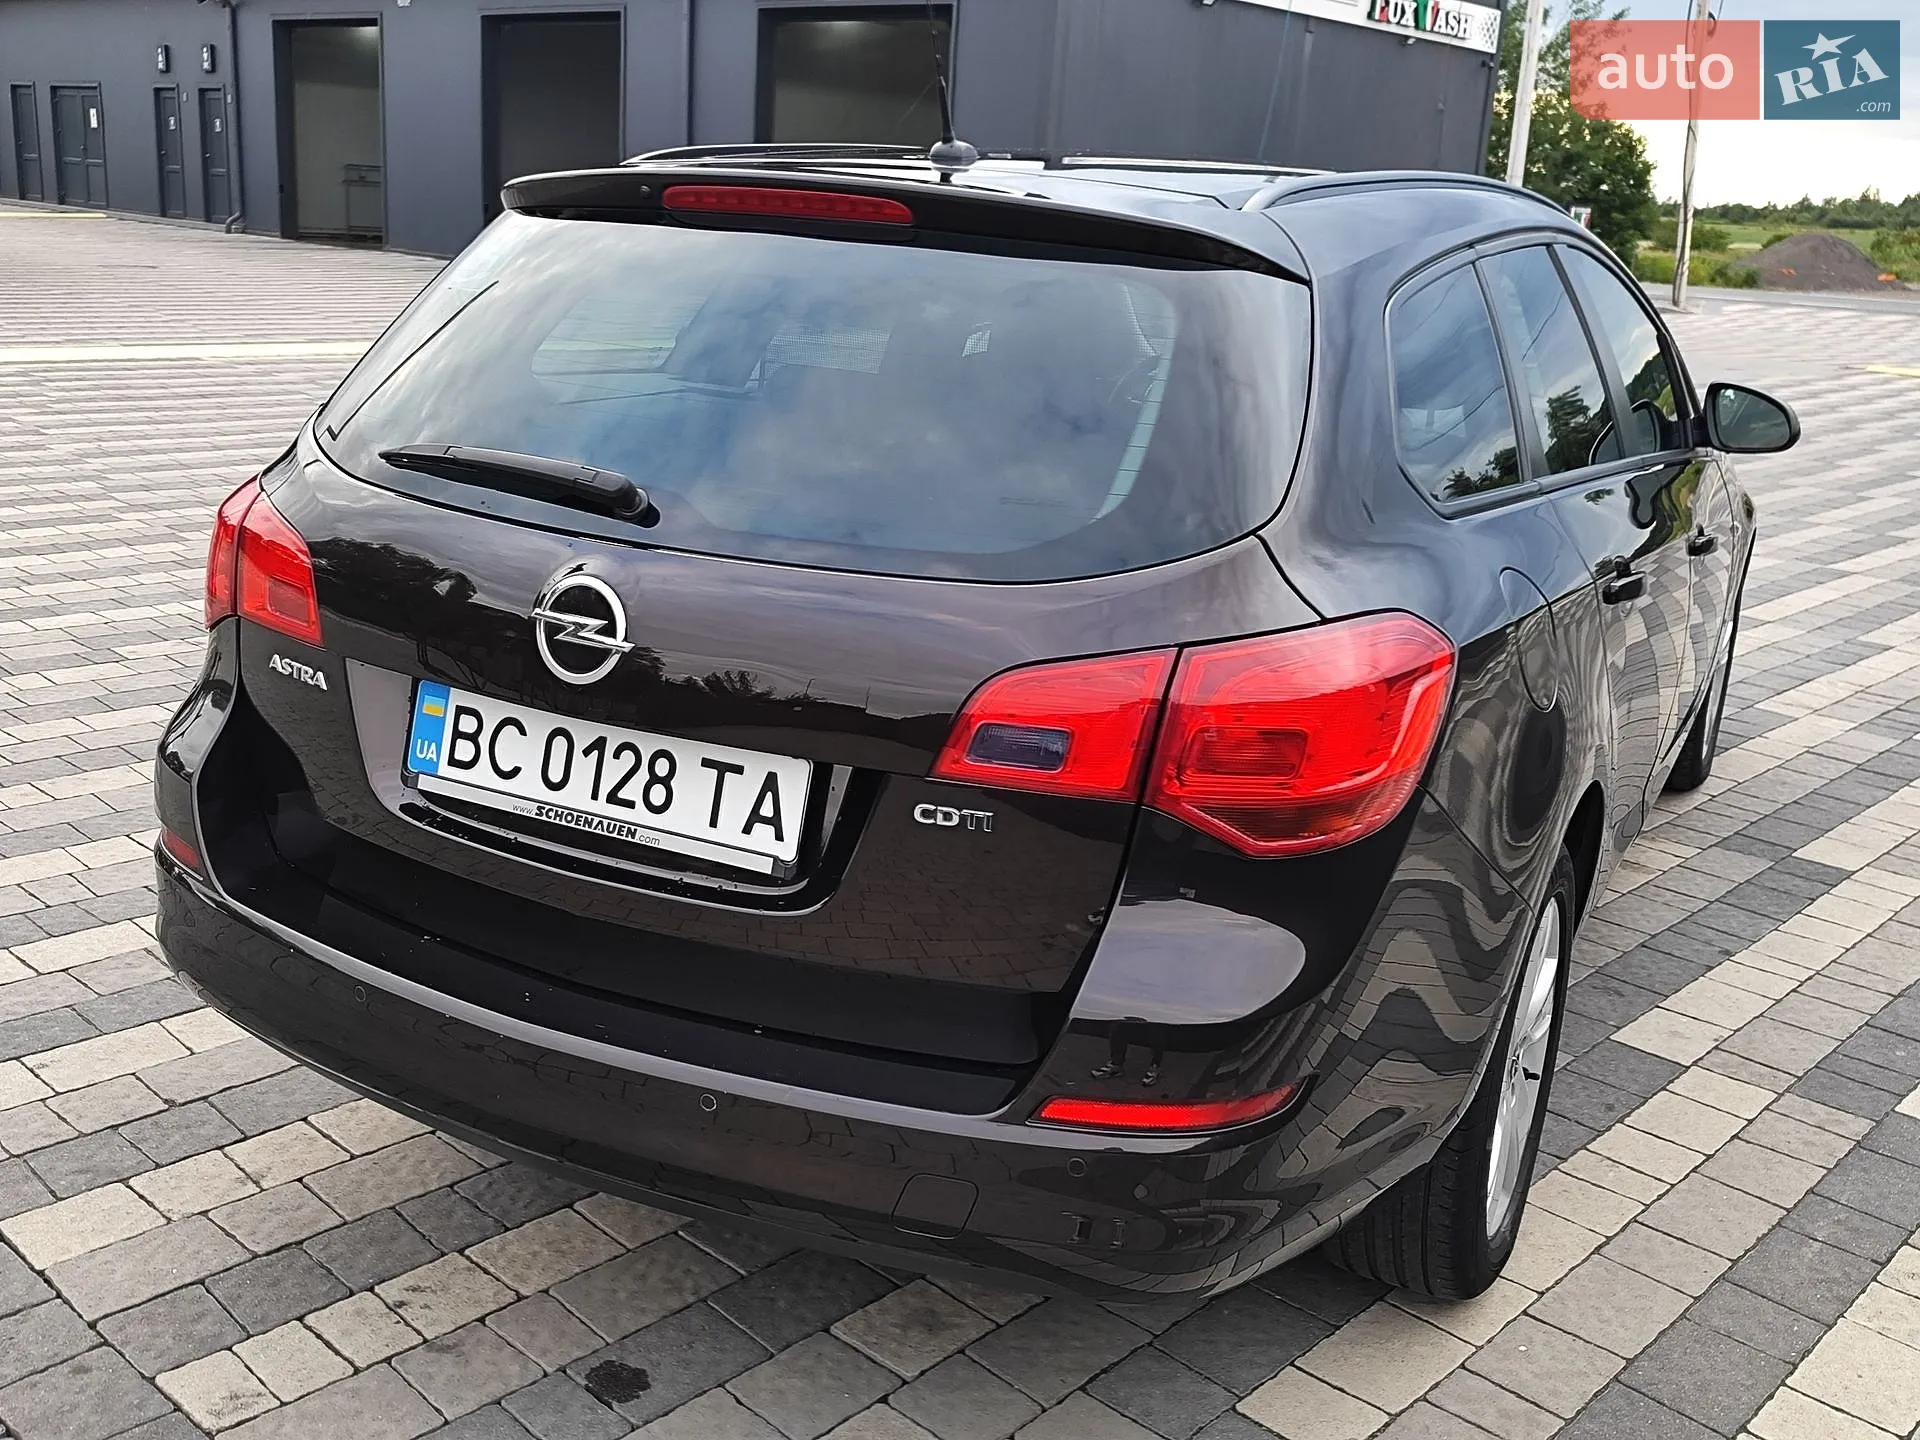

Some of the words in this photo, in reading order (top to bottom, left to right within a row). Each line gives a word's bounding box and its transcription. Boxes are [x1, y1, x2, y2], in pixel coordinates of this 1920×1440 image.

[268, 653, 328, 691] ASTRA
[416, 738, 438, 763] UA
[446, 704, 527, 780] BC
[541, 726, 677, 815] 0128
[700, 757, 785, 842] TA
[512, 803, 661, 846] www.SCHOENAUEN.com
[913, 803, 994, 833] CDTI
